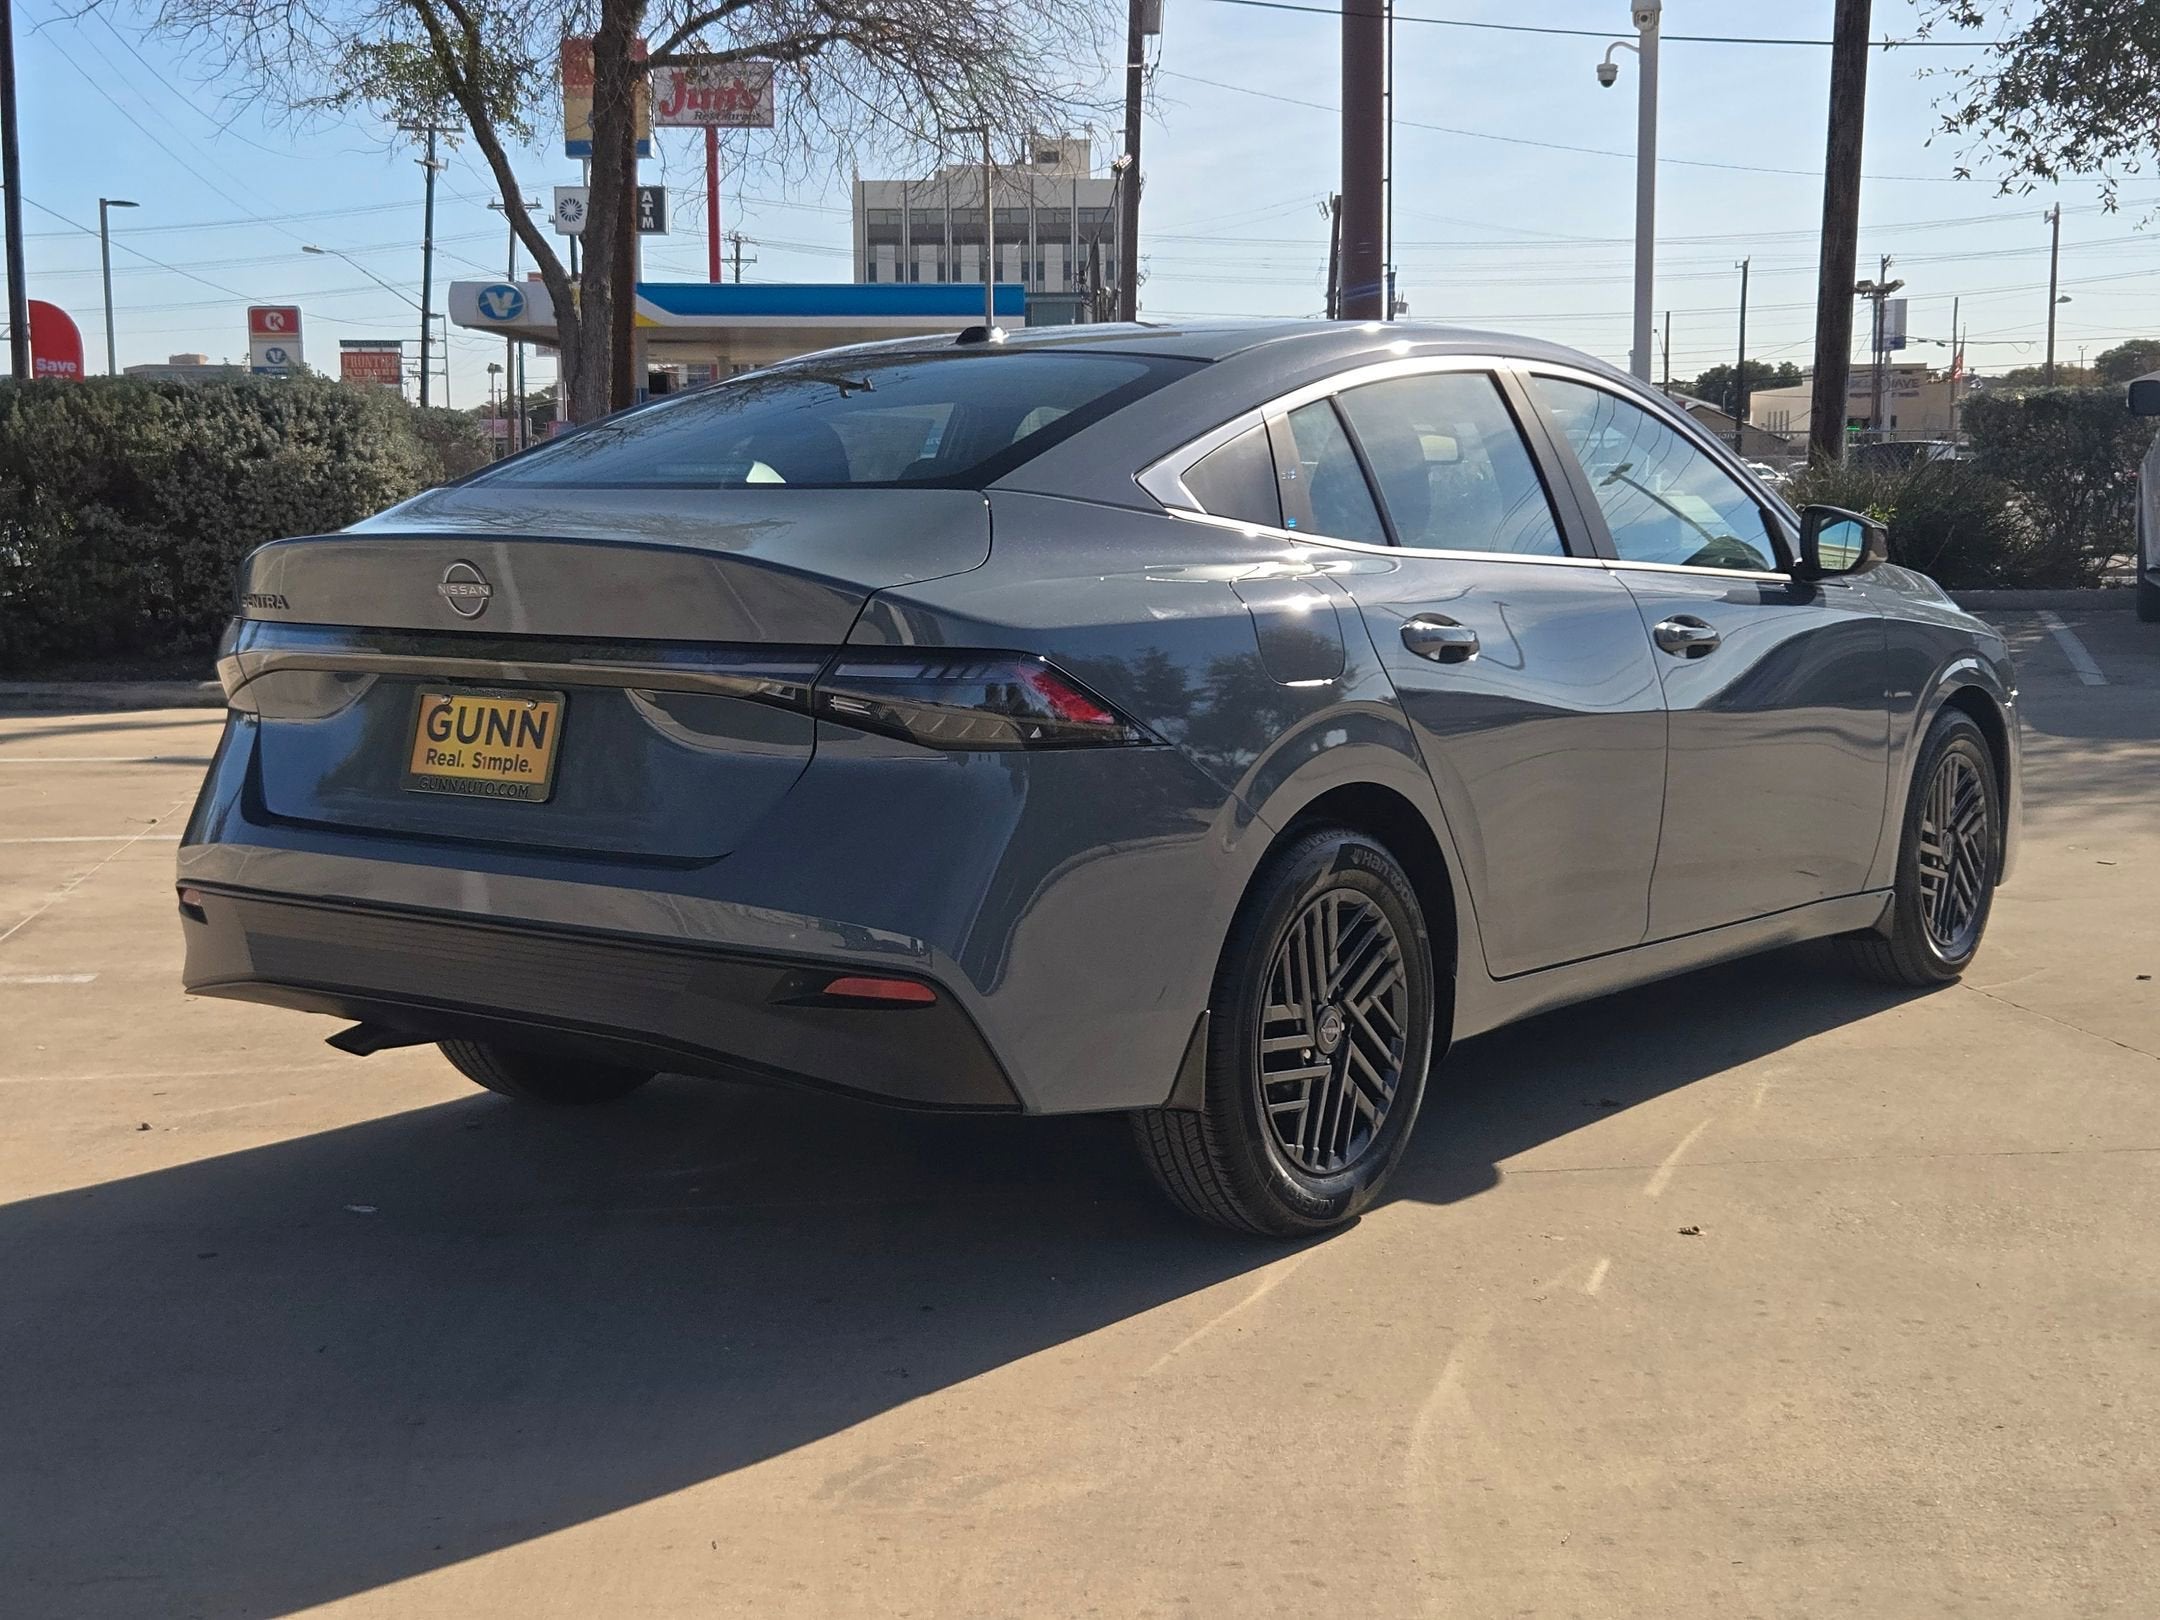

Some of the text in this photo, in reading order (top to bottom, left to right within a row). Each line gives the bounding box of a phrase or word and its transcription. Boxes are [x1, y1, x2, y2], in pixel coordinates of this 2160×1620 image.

[641, 190, 654, 229] ATM
[36, 357, 77, 373] Save
[438, 584, 489, 596] NISSAN
[242, 593, 289, 610] SENTRA
[426, 703, 550, 750] GUNN
[425, 747, 465, 768] Real.
[418, 775, 529, 798] GUNNAUTO.COM
